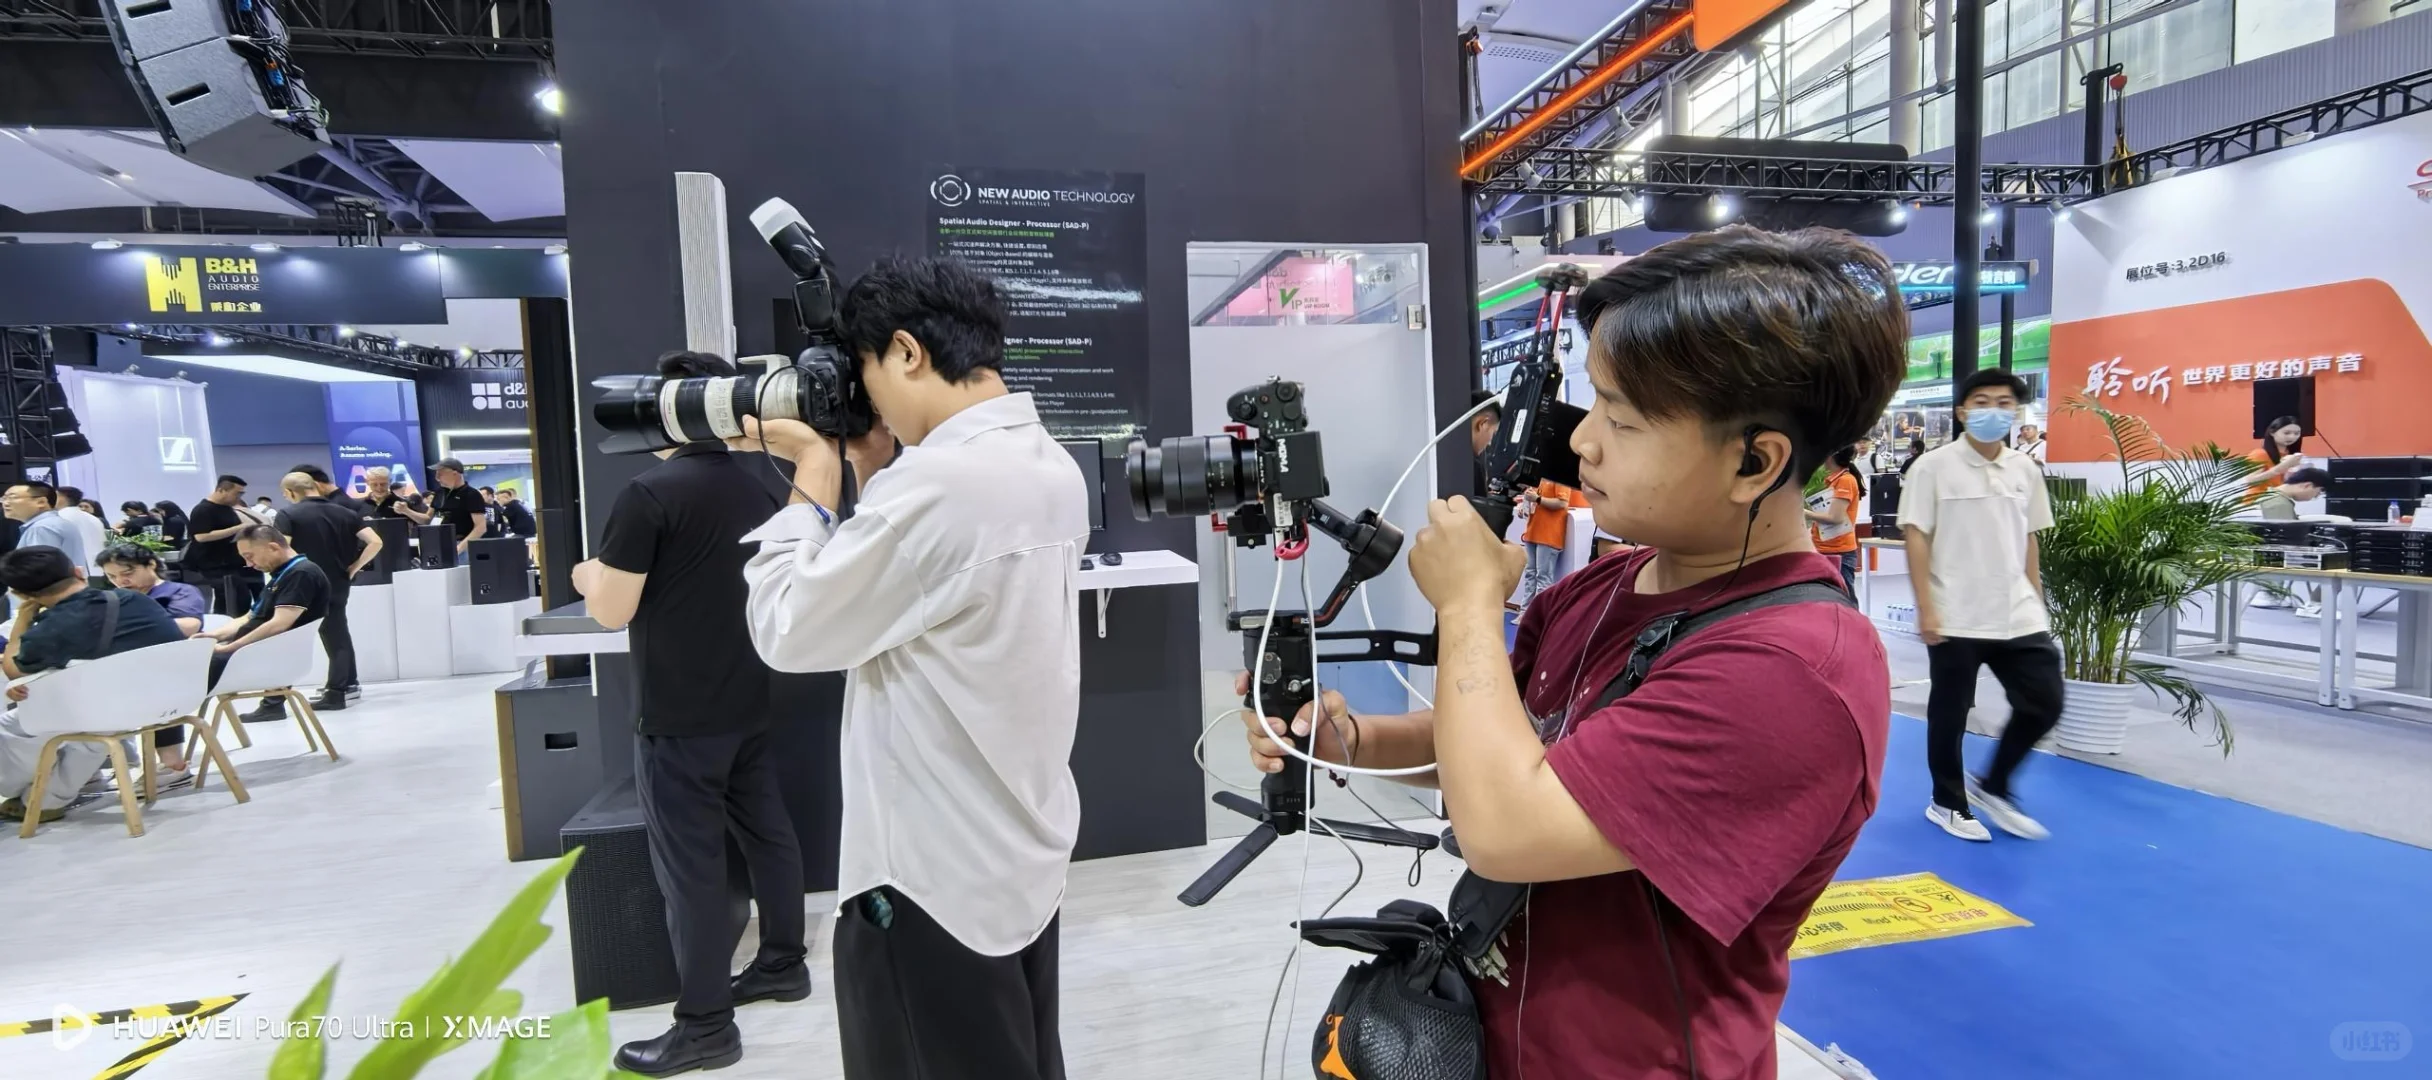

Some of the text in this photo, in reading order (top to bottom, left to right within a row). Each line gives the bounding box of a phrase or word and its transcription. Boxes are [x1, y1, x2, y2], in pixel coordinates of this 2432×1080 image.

[978, 188, 1135, 204] NEW AUDIO TECHNOLOGY
[939, 217, 965, 226] Spatial
[966, 218, 987, 226] Audio
[989, 219, 1020, 228] Designer
[1026, 220, 1060, 229] Processor
[1062, 221, 1089, 230] (SAD-P)
[205, 257, 257, 274] B&H
[208, 275, 259, 283] AUDIO
[208, 283, 260, 291] ENTERPRISE
[1029, 337, 1063, 345] Processor
[1065, 337, 1092, 346] (SAD-P)
[2182, 354, 2364, 386] 世界更好的声音
